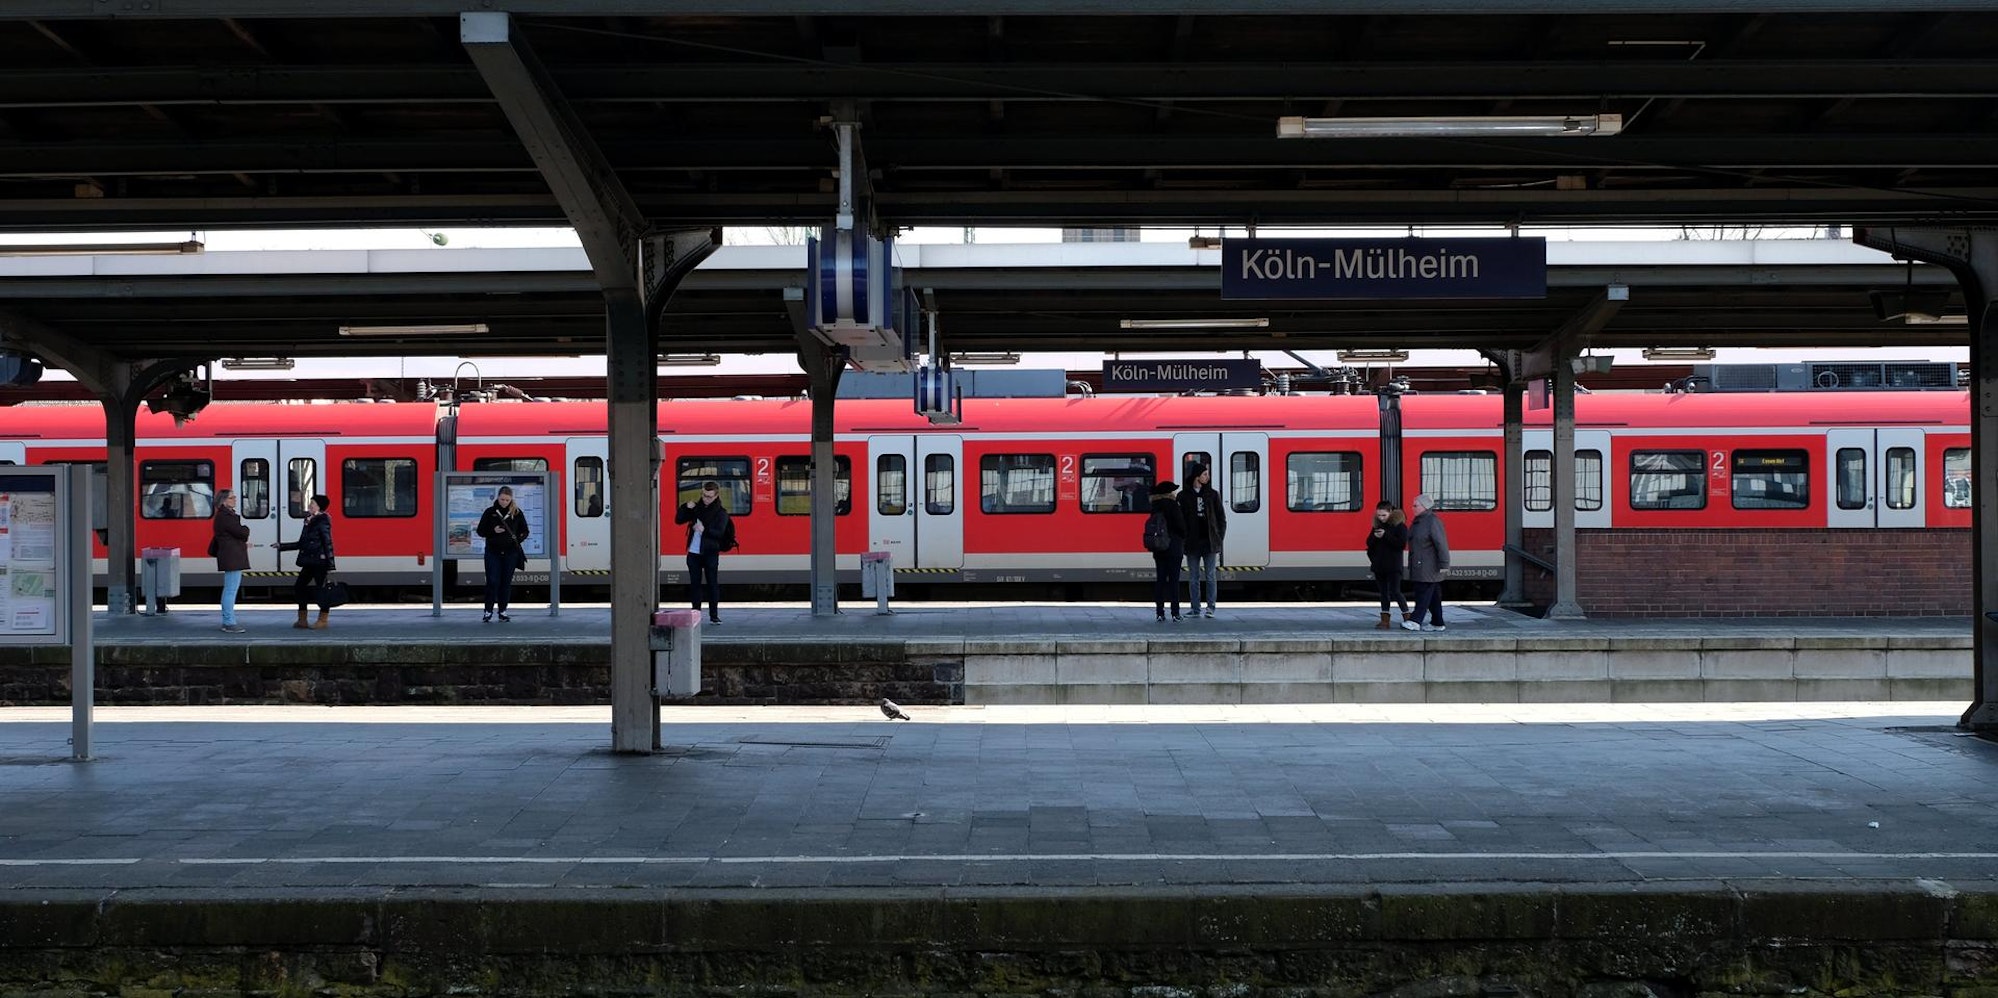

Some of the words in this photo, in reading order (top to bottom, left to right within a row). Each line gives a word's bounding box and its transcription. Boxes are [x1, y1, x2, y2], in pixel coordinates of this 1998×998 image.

[1241, 248, 1479, 280] Köln-Mülheim
[1111, 364, 1228, 381] Köln-Mülheim
[757, 458, 769, 476] 2
[1061, 456, 1073, 474] 2
[1712, 451, 1724, 470] 2
